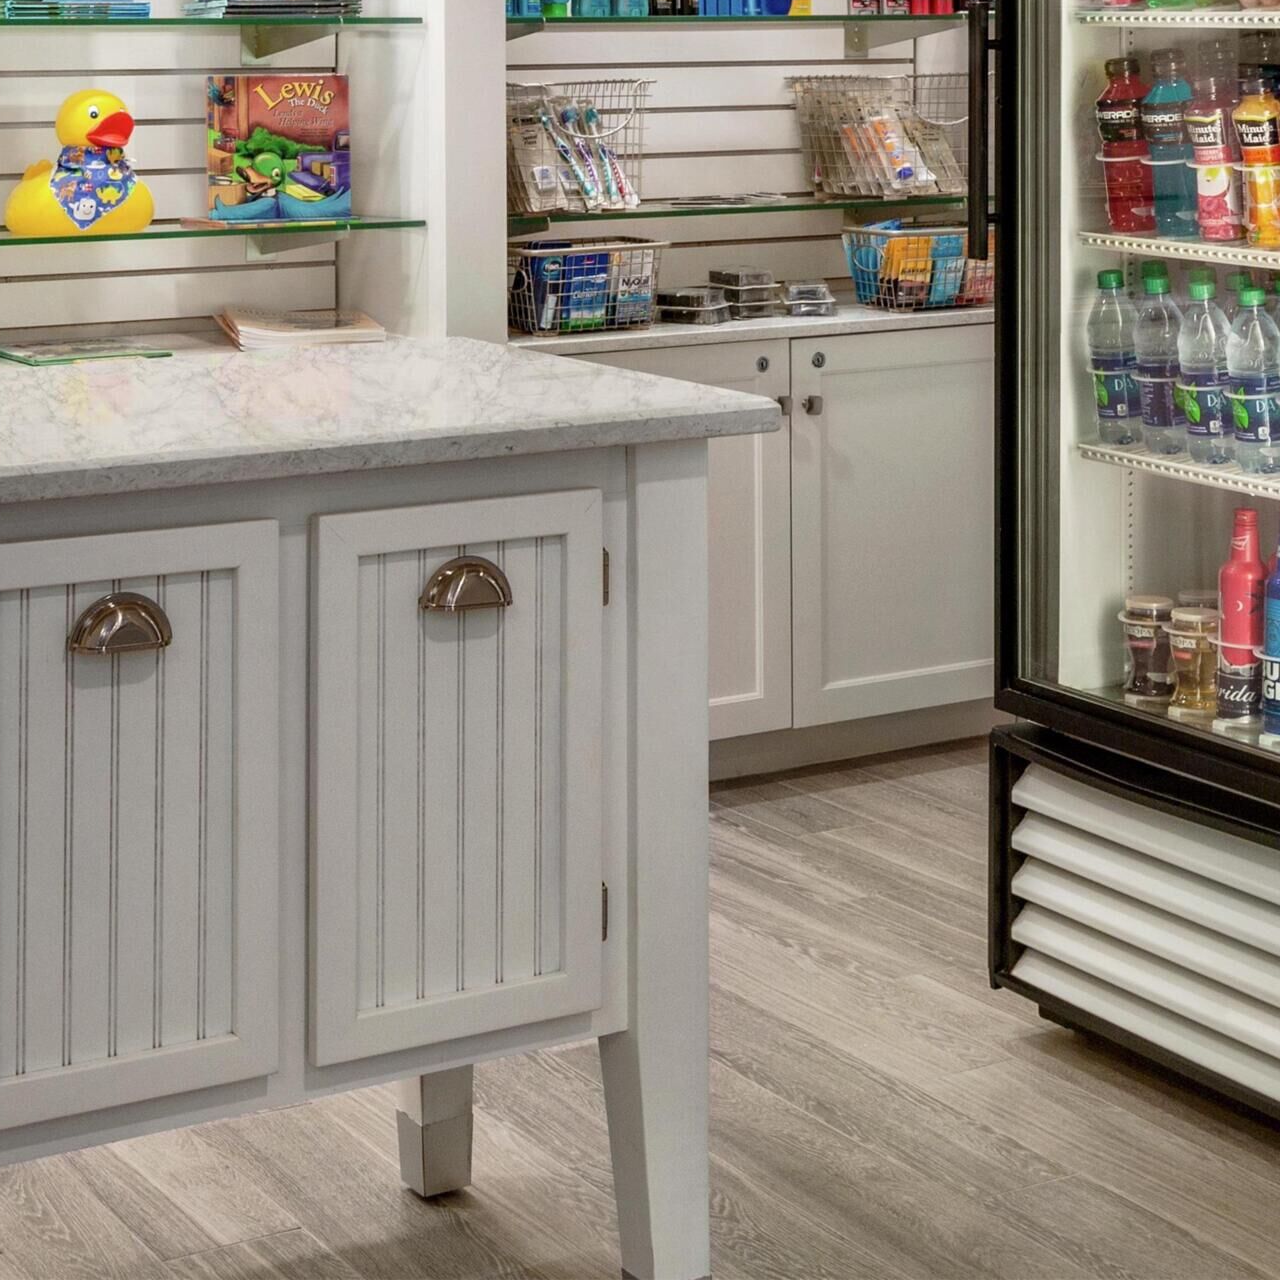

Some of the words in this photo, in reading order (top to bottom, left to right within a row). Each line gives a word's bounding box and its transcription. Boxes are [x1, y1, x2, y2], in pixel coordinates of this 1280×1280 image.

[254, 80, 335, 110] Lewis
[288, 98, 304, 107] The
[306, 98, 328, 115] Duck
[1238, 124, 1273, 134] Minute
